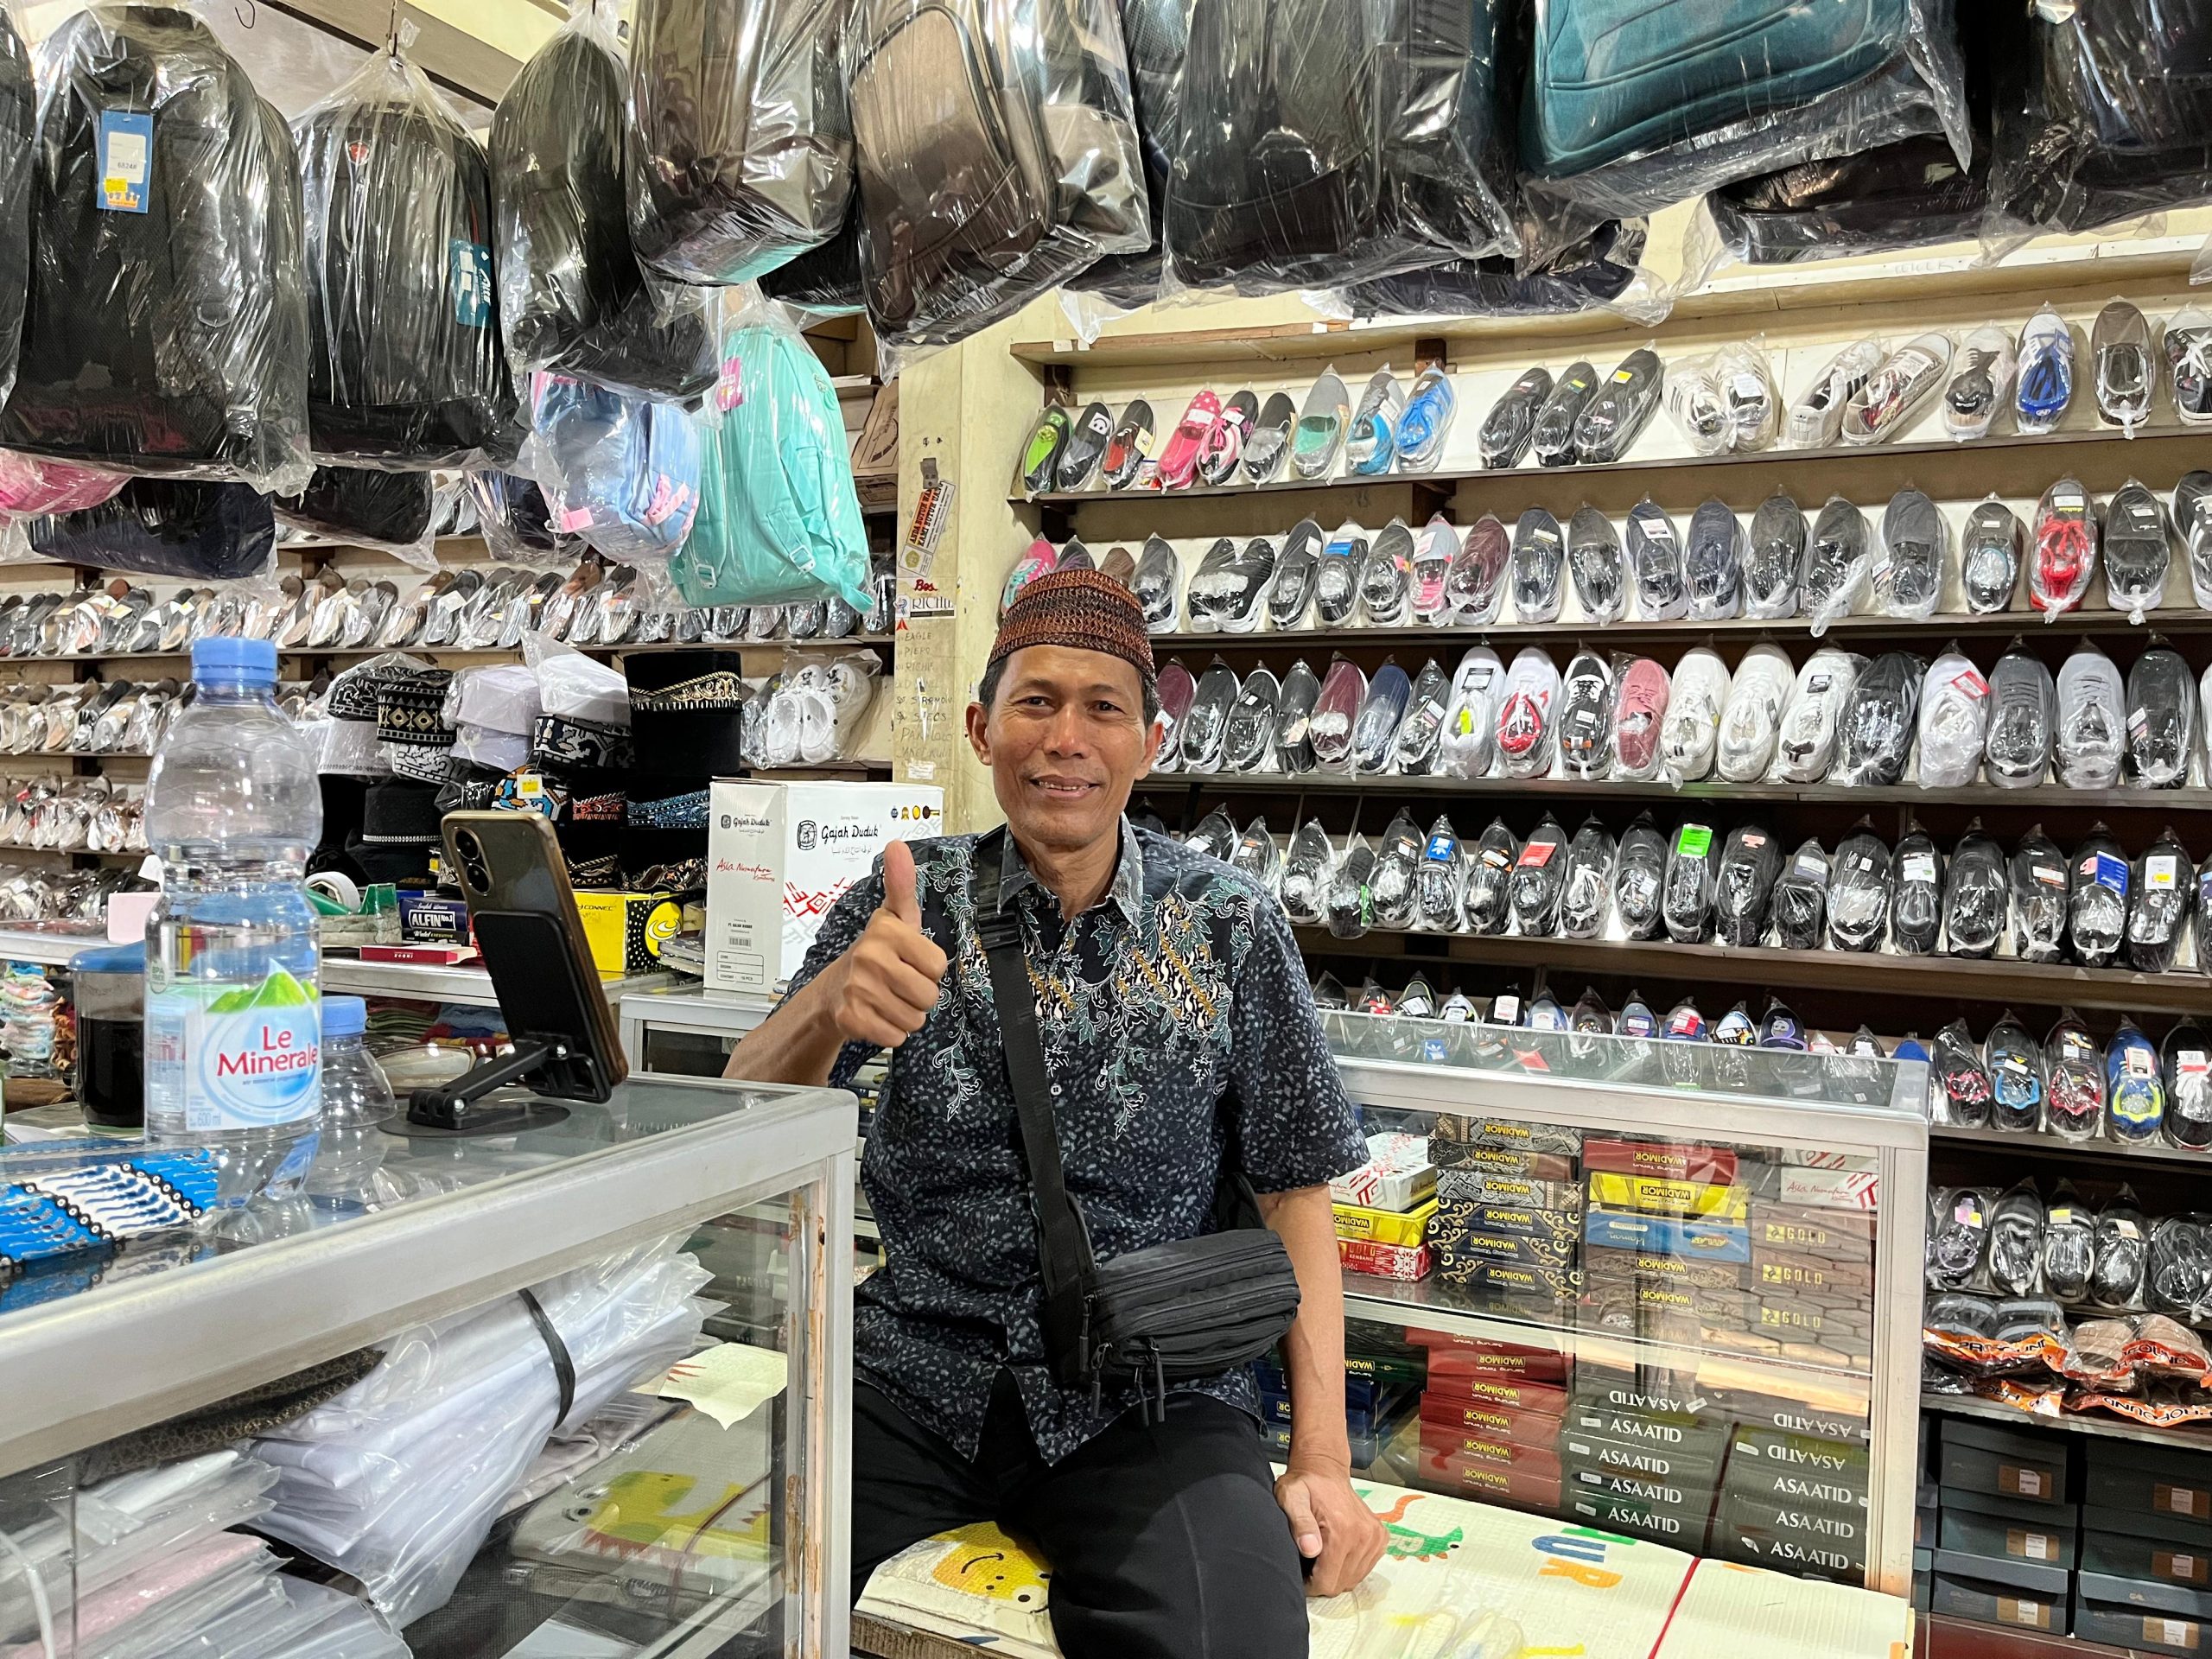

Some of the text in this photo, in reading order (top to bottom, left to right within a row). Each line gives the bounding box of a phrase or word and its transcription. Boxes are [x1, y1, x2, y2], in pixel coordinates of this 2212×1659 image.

[910, 525, 920, 544] ANDA
[915, 502, 927, 525] BUTUH
[917, 526, 929, 547] KAMI
[924, 502, 936, 527] BUTUH
[905, 632, 932, 641] EAGLE
[733, 817, 770, 828] Gajah Duduk
[822, 823, 879, 844] Gajah Duduk
[412, 913, 442, 926] ALFIN
[263, 1026, 292, 1051] Le
[217, 1043, 318, 1077] Minerale
[1484, 1124, 1530, 1137] WADIMOR
[1474, 1151, 1520, 1164] WADIMOR
[1635, 1151, 1684, 1165] WADIMOR
[1484, 1181, 1530, 1194] WADIMOR
[1643, 1185, 1689, 1198] WADIMOR
[1334, 1215, 1369, 1228] WADIMO
[1485, 1210, 1532, 1223] WADIMOR
[1472, 1236, 1517, 1250] WADIMOR
[1787, 1227, 1825, 1244] GOLD
[1637, 1259, 1685, 1272] WADIMOR
[1489, 1269, 1534, 1282] WADIMOR
[1784, 1268, 1822, 1285] GOLD
[1642, 1290, 1690, 1304] WADIMOR
[1783, 1311, 1821, 1328] GOLD
[1344, 1360, 1373, 1370] WADIM
[1478, 1355, 1524, 1366] WADIMOR
[1474, 1382, 1518, 1398] WADIMOR
[1609, 1389, 1681, 1412] ASAATID
[1465, 1410, 1510, 1426] WADIMOR
[1773, 1413, 1852, 1437] ASAATID
[1610, 1418, 1682, 1443] ASAATID
[1466, 1440, 1510, 1456] WADIMOR
[1599, 1448, 1670, 1475] ASAATID
[1768, 1445, 1846, 1470] ASAATID
[1464, 1469, 1508, 1484] WADIMOR
[1610, 1478, 1682, 1503] ASAATID
[1773, 1477, 1852, 1503] ASAATID
[1608, 1507, 1680, 1534] ASAATID
[1776, 1510, 1854, 1538] ASAATID
[1770, 1541, 1849, 1570] ASAATID
